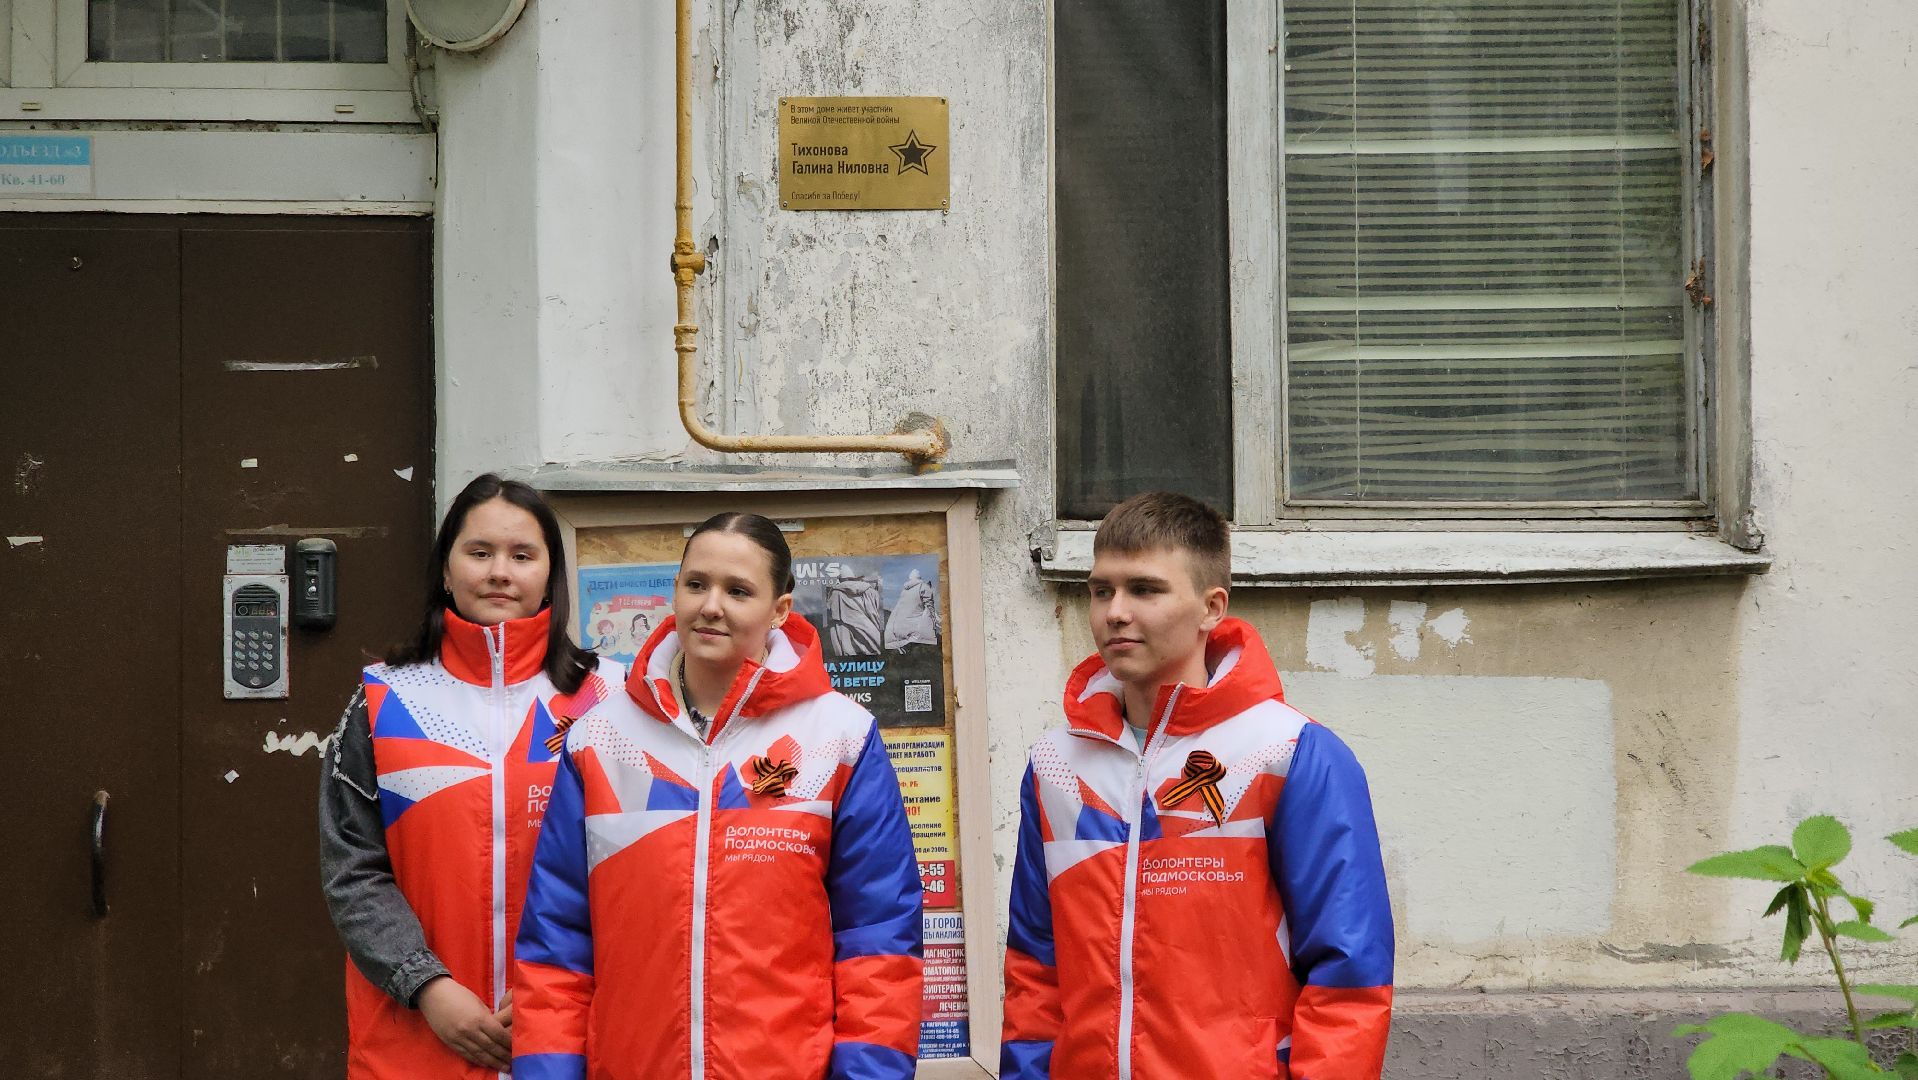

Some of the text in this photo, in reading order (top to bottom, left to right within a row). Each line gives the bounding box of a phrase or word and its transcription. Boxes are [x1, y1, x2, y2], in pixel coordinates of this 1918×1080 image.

[816, 106, 835, 114] доме
[861, 106, 893, 115] участник
[790, 116, 900, 124] Великой Отечественной войны
[791, 143, 849, 156] Тихонова
[792, 161, 889, 174] Галина Ниловна
[791, 192, 821, 200] Спасибо
[832, 191, 861, 201] Победу!
[796, 562, 841, 578] WKS
[589, 580, 618, 591] ДЕТИ
[797, 578, 841, 586] TORTUGA
[839, 661, 885, 674] УЛИЦУ
[843, 676, 886, 688] ВЕТЕР
[901, 741, 945, 750] ОРГАНИЗАЦИЯ
[903, 751, 913, 759] НА
[913, 750, 936, 758] РАБОТУ
[903, 795, 941, 804] Питание
[726, 825, 811, 841] ВОЛОНТЕРЫ
[725, 854, 775, 863] МЫ РЯДОМ
[1142, 857, 1224, 870] ВОЛОНТЕРЫ
[1142, 871, 1244, 883] ПОДМОСКОВЬЯ
[1155, 886, 1187, 896] РЯДОМ
[924, 917, 963, 929] В ГОРОД
